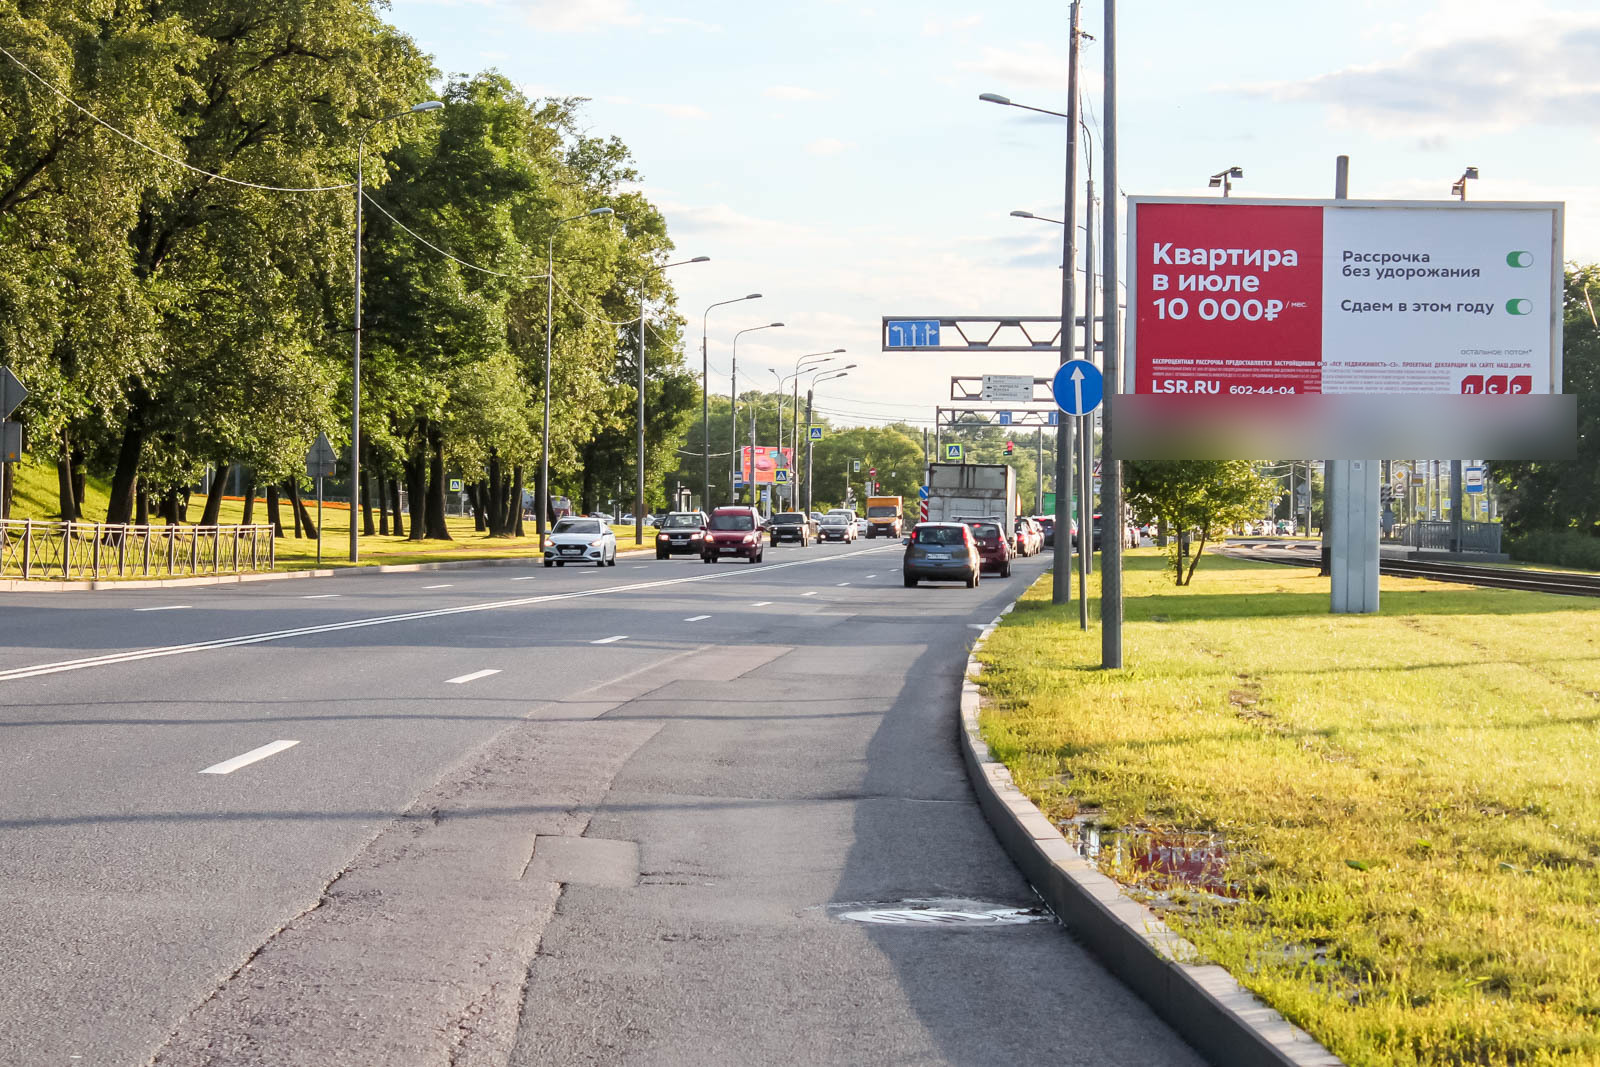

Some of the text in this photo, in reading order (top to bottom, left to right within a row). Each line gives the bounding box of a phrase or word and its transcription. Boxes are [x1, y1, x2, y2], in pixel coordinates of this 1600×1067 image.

[1153, 242, 1298, 272] Квартира
[1342, 250, 1430, 265] Рассрочка
[1342, 264, 1480, 280] без удорожания
[1152, 274, 1260, 292] в июле
[1153, 297, 1189, 320] 10
[1341, 299, 1495, 315] Сдаем в этом году
[1152, 379, 1220, 394] LSR.RU
[1229, 385, 1296, 394] 602-44-04
